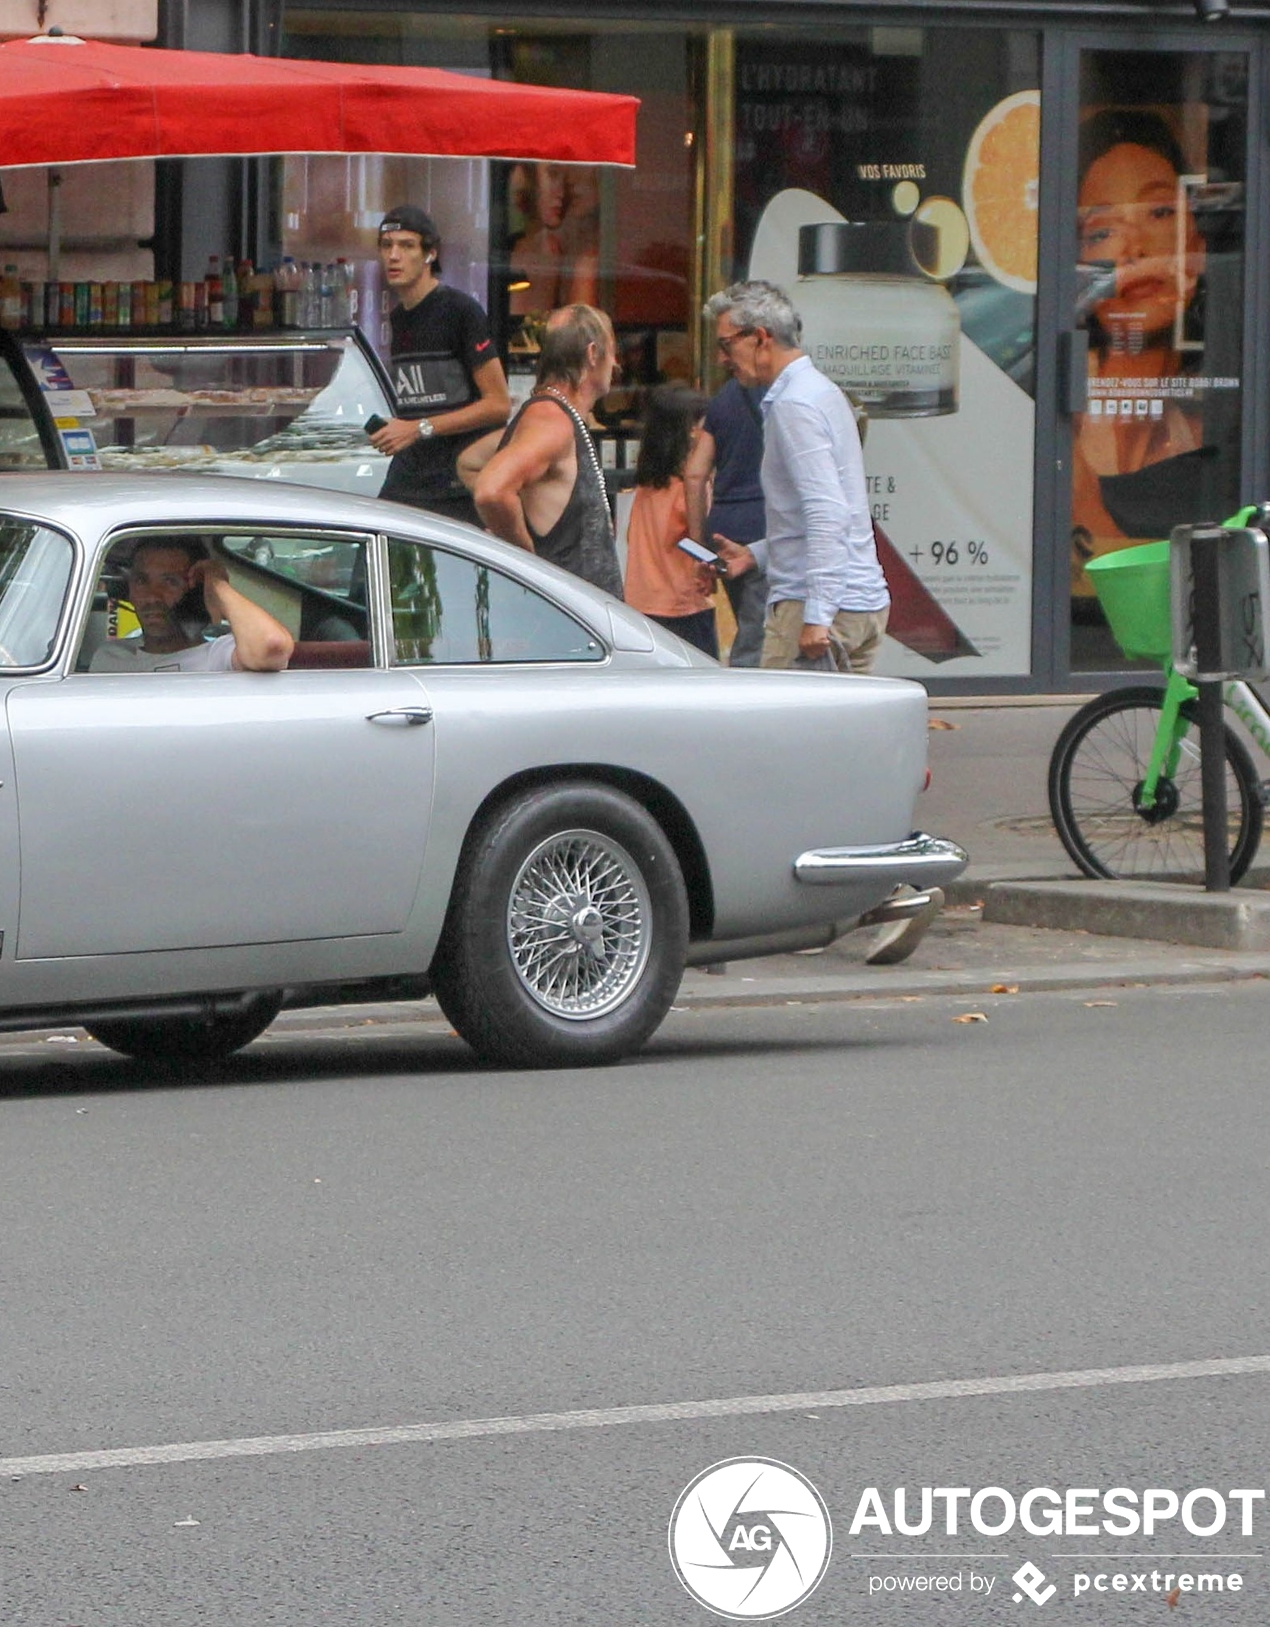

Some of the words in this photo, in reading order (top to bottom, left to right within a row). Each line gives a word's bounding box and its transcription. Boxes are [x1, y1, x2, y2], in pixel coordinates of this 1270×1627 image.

[859, 165, 880, 179] VOS
[883, 164, 926, 179] FAVORIS
[817, 345, 889, 361] ENRICHED
[894, 345, 926, 361] FACE
[823, 363, 892, 376] MAQUILLAGE
[1161, 377, 1169, 388] LE
[1171, 377, 1187, 388] SITE
[887, 476, 896, 493] &
[930, 541, 959, 565] 96
[968, 541, 989, 565] %
